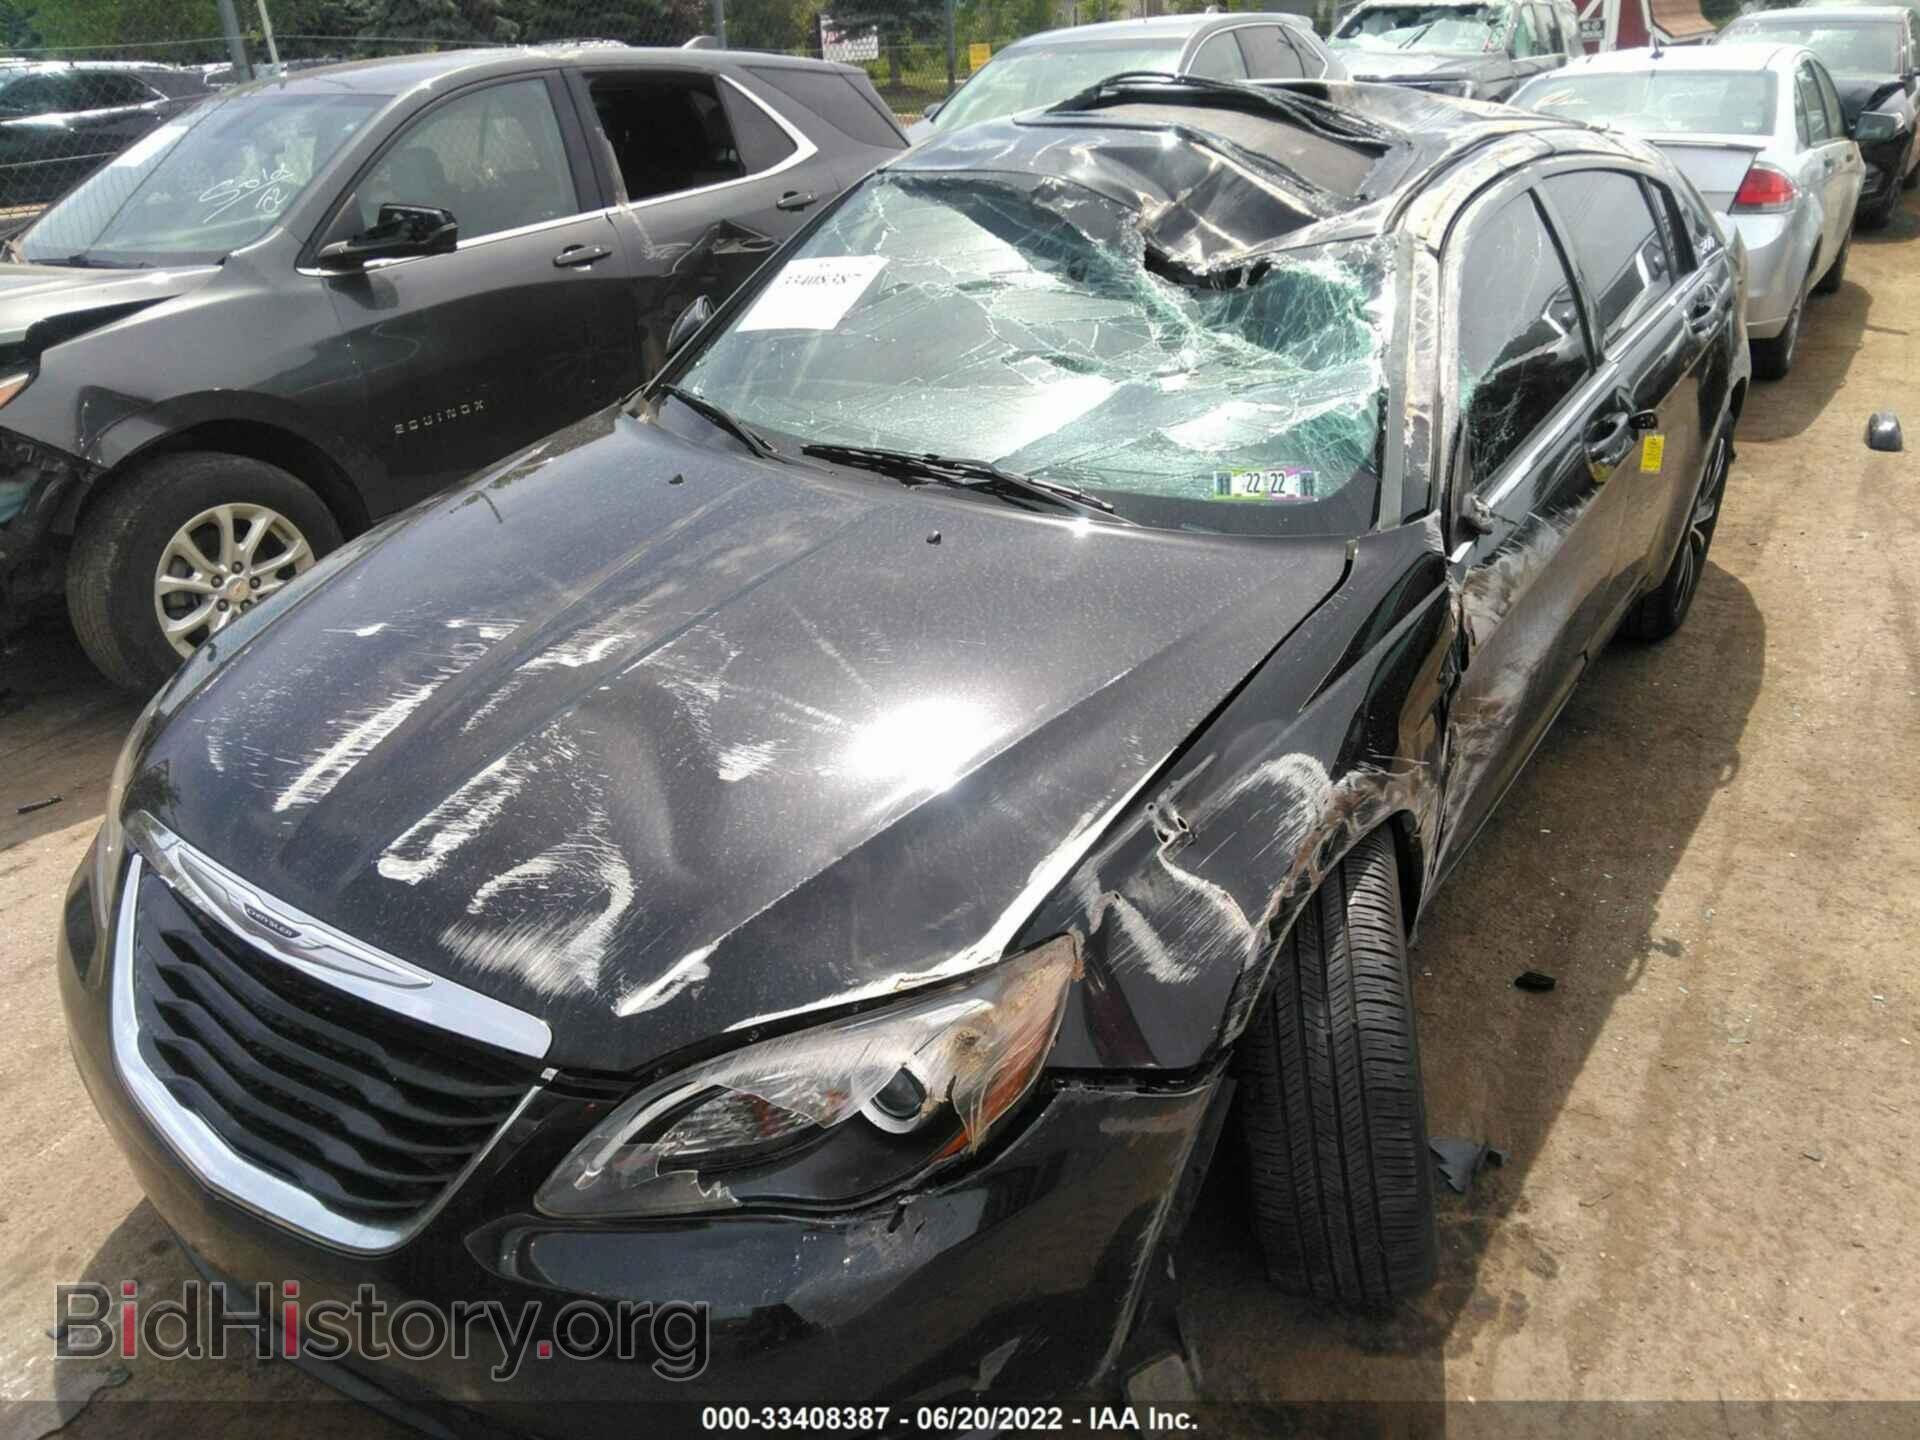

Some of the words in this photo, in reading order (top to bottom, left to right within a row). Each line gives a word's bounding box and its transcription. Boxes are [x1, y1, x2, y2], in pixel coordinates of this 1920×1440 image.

[198, 162, 295, 207] Sold
[393, 399, 486, 435] EQUINOX
[1246, 472, 1261, 494] 22
[1270, 472, 1286, 494] 22
